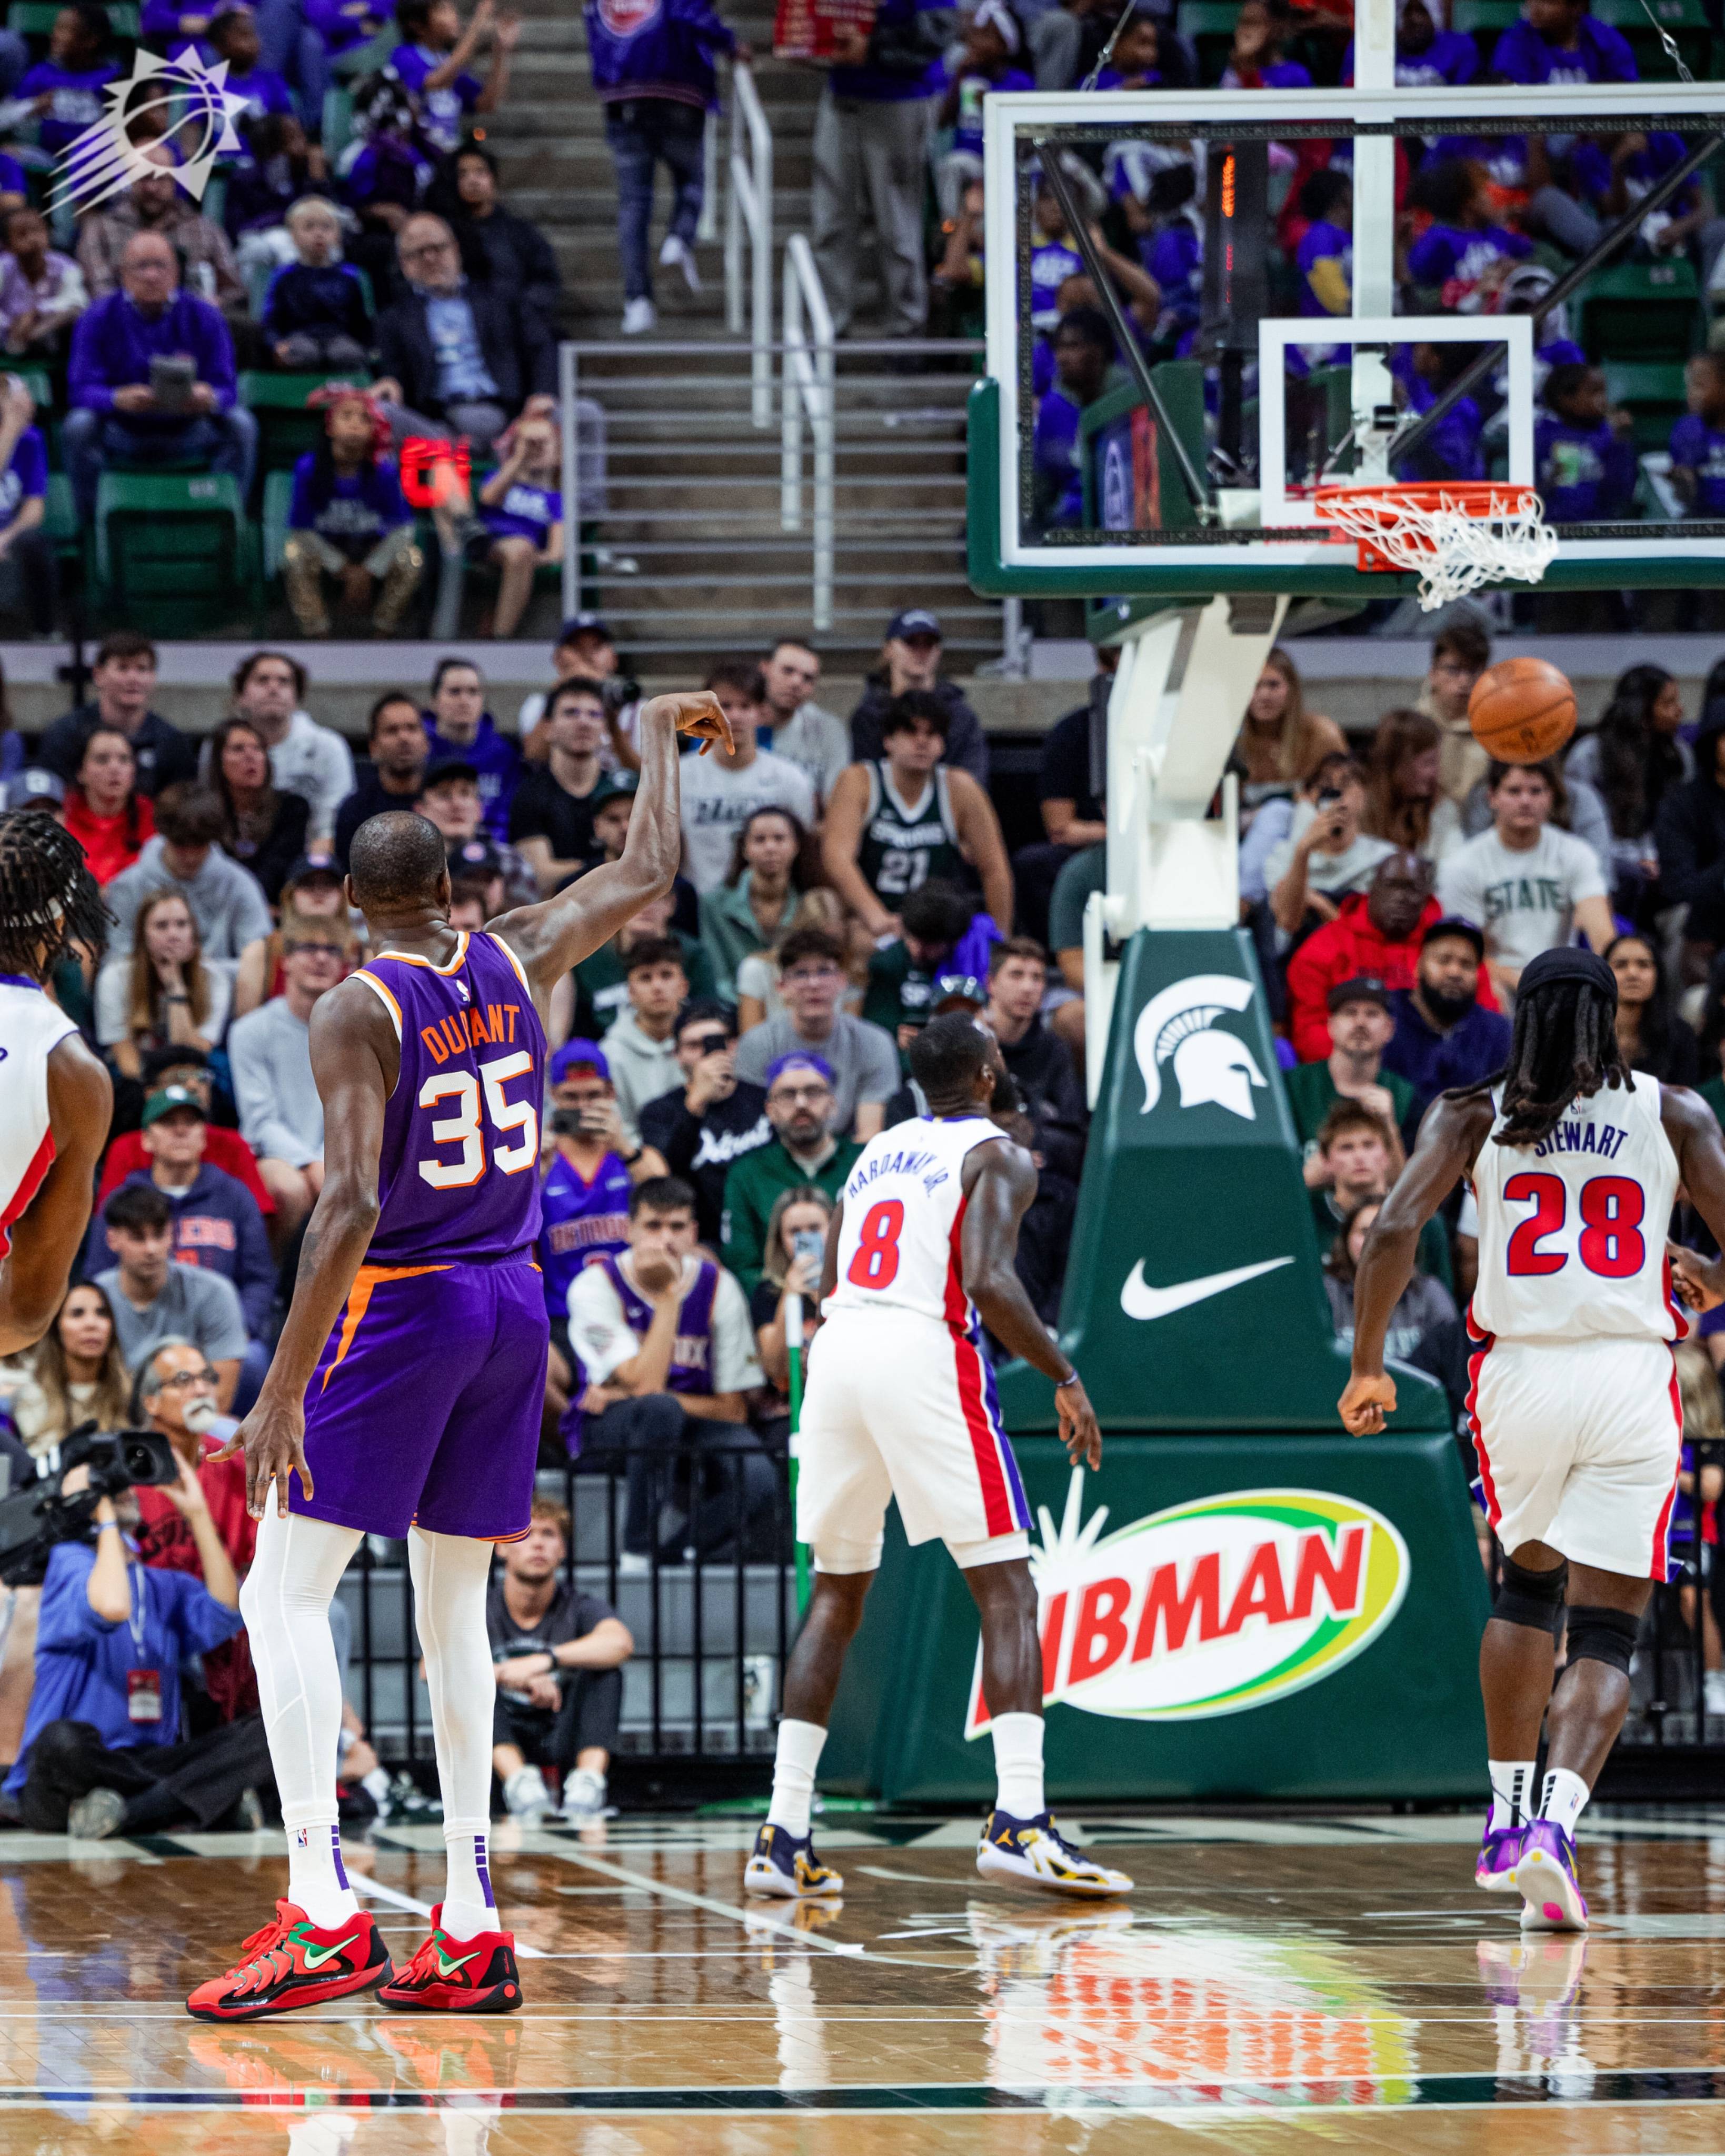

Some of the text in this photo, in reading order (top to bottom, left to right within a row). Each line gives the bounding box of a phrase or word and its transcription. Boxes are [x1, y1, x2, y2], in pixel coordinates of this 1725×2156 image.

[1483, 877, 1562, 919] STATE
[419, 1050, 539, 1191] 35
[1534, 1121, 1629, 1160] STEWART
[847, 1199, 904, 1291] 8
[1503, 1172, 1645, 1278] 28
[973, 1527, 1365, 1728] IBMAN
